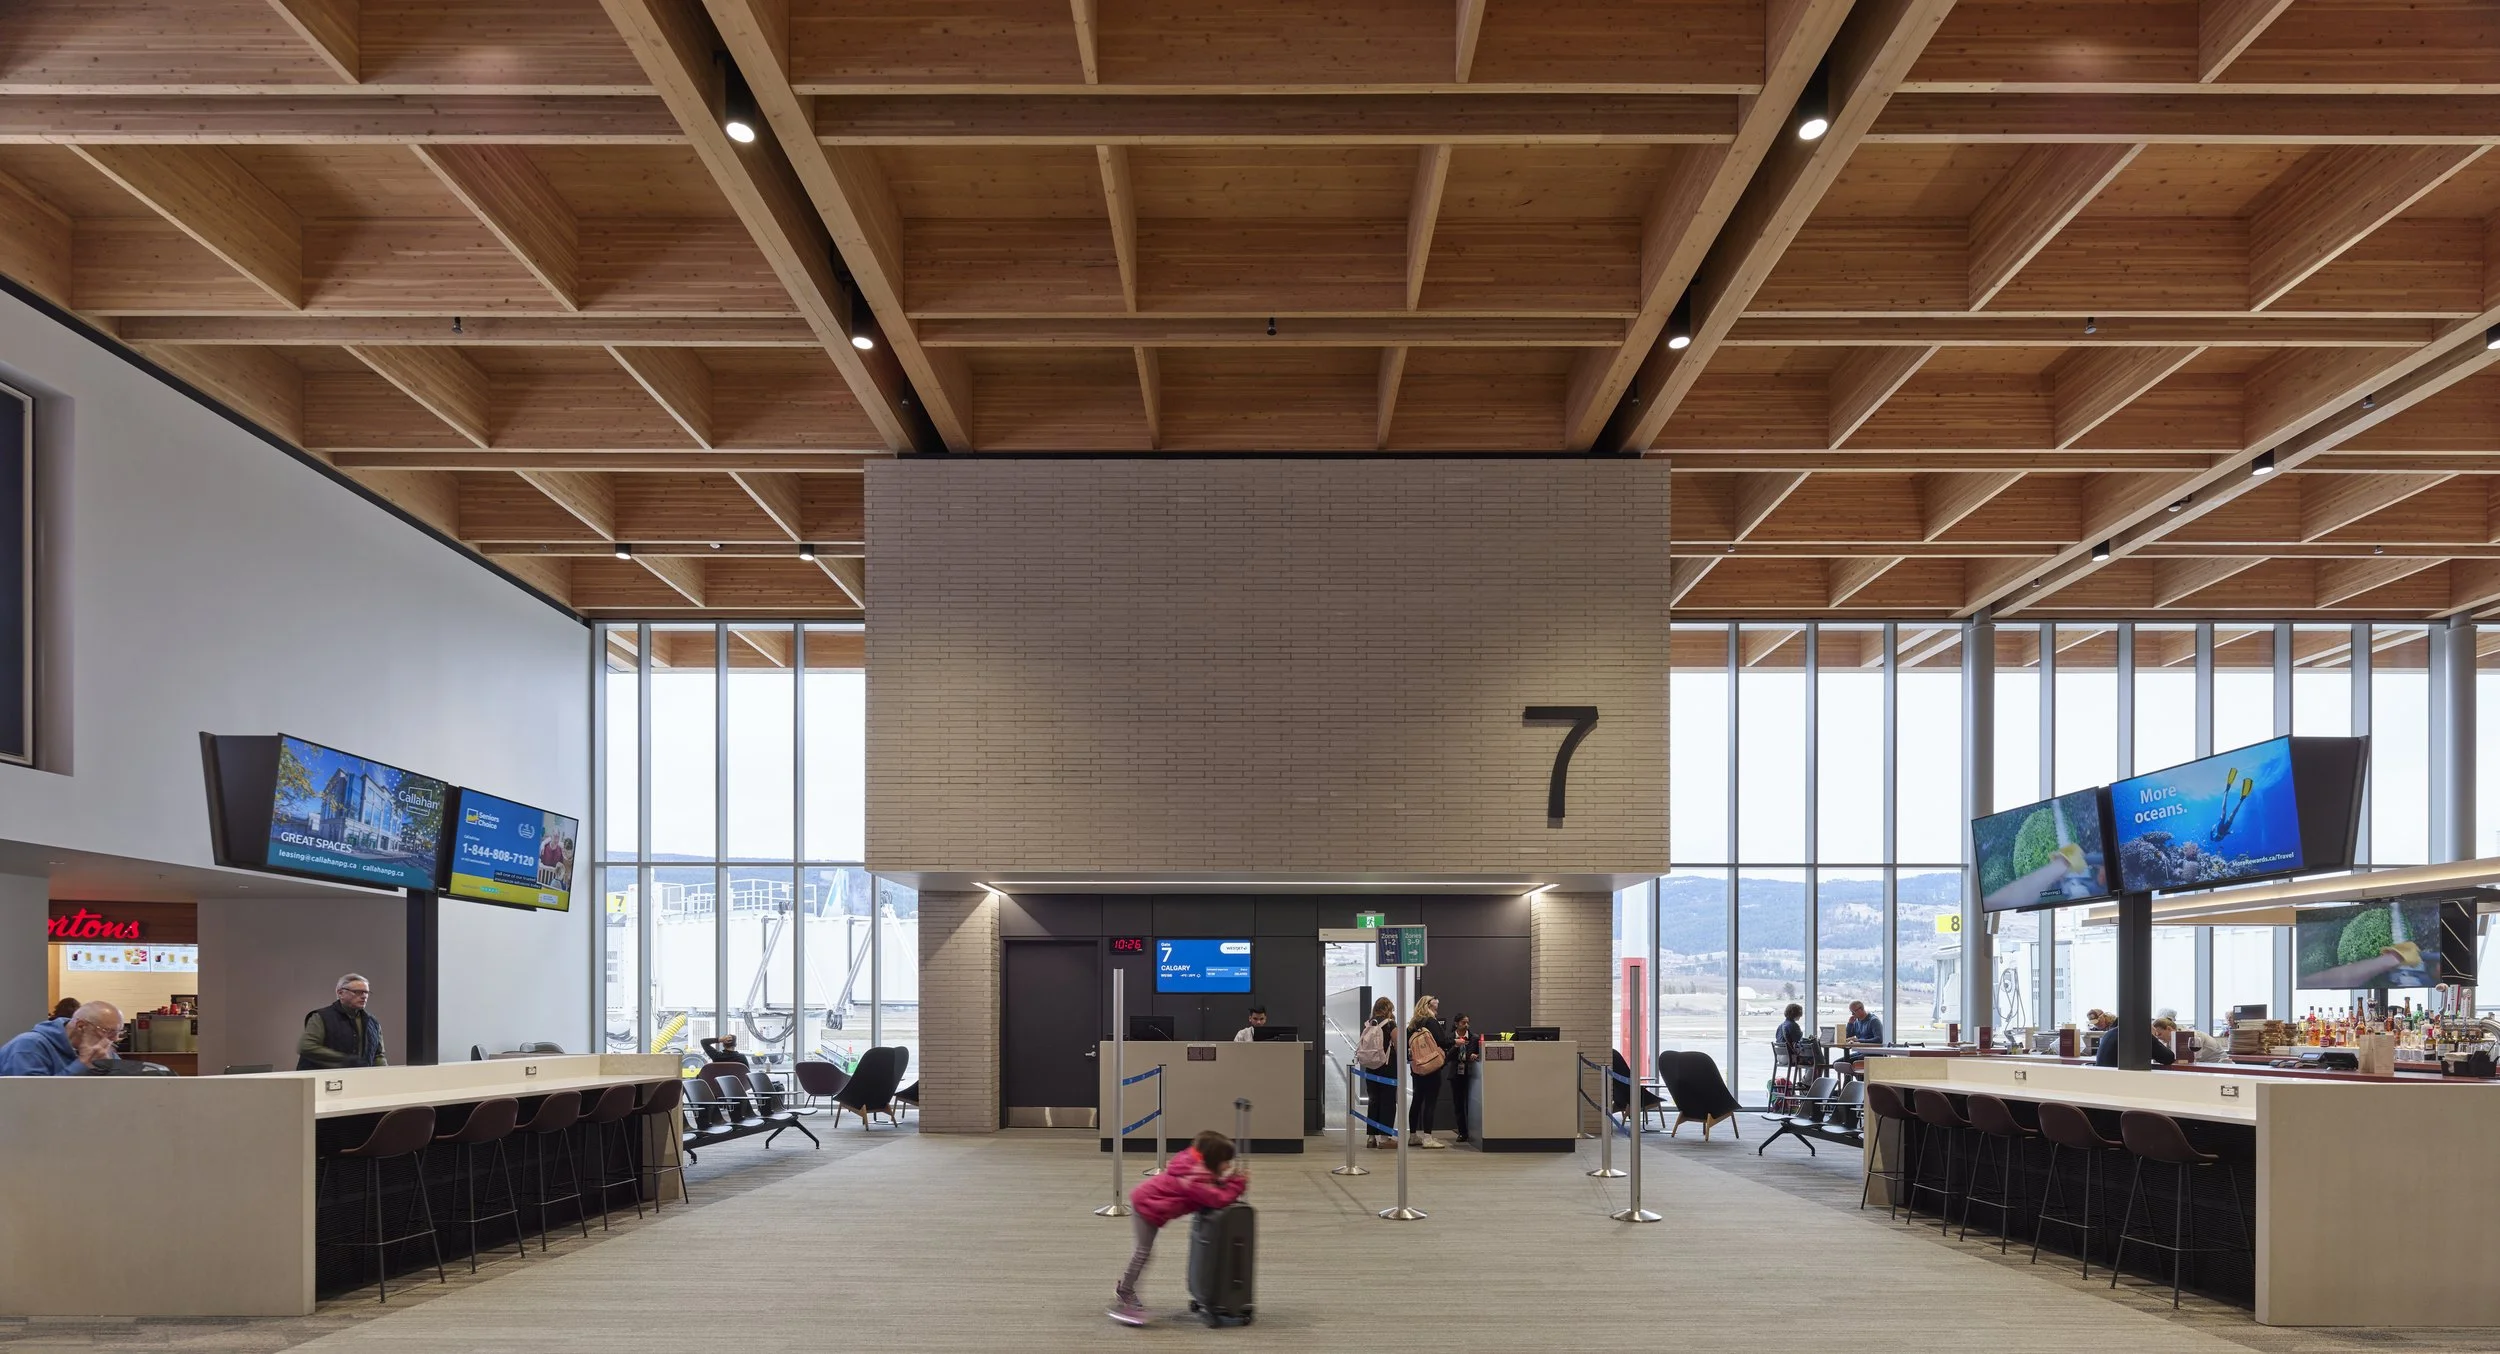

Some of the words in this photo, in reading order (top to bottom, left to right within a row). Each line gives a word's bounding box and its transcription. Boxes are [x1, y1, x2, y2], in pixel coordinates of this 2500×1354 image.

[1525, 706, 1599, 818] 7
[398, 791, 438, 809] Callahan
[2140, 784, 2177, 804] More
[479, 812, 499, 823] Seniors
[2135, 802, 2188, 824] oceans.
[478, 819, 497, 829] Choice
[281, 832, 314, 846] GREAT
[316, 838, 353, 854] SPACES
[279, 849, 357, 869] leasing@callahanpg.ca
[362, 864, 404, 876] callahanpg.ca
[462, 842, 535, 867] 1-844-808-7120
[2232, 852, 2295, 867] MoreRewards.ca/Travel
[615, 895, 625, 912] 7
[1951, 915, 1960, 932] 8
[1114, 939, 1142, 949] 10:26
[1383, 938, 1397, 946] 1-2
[1161, 947, 1172, 963] 7
